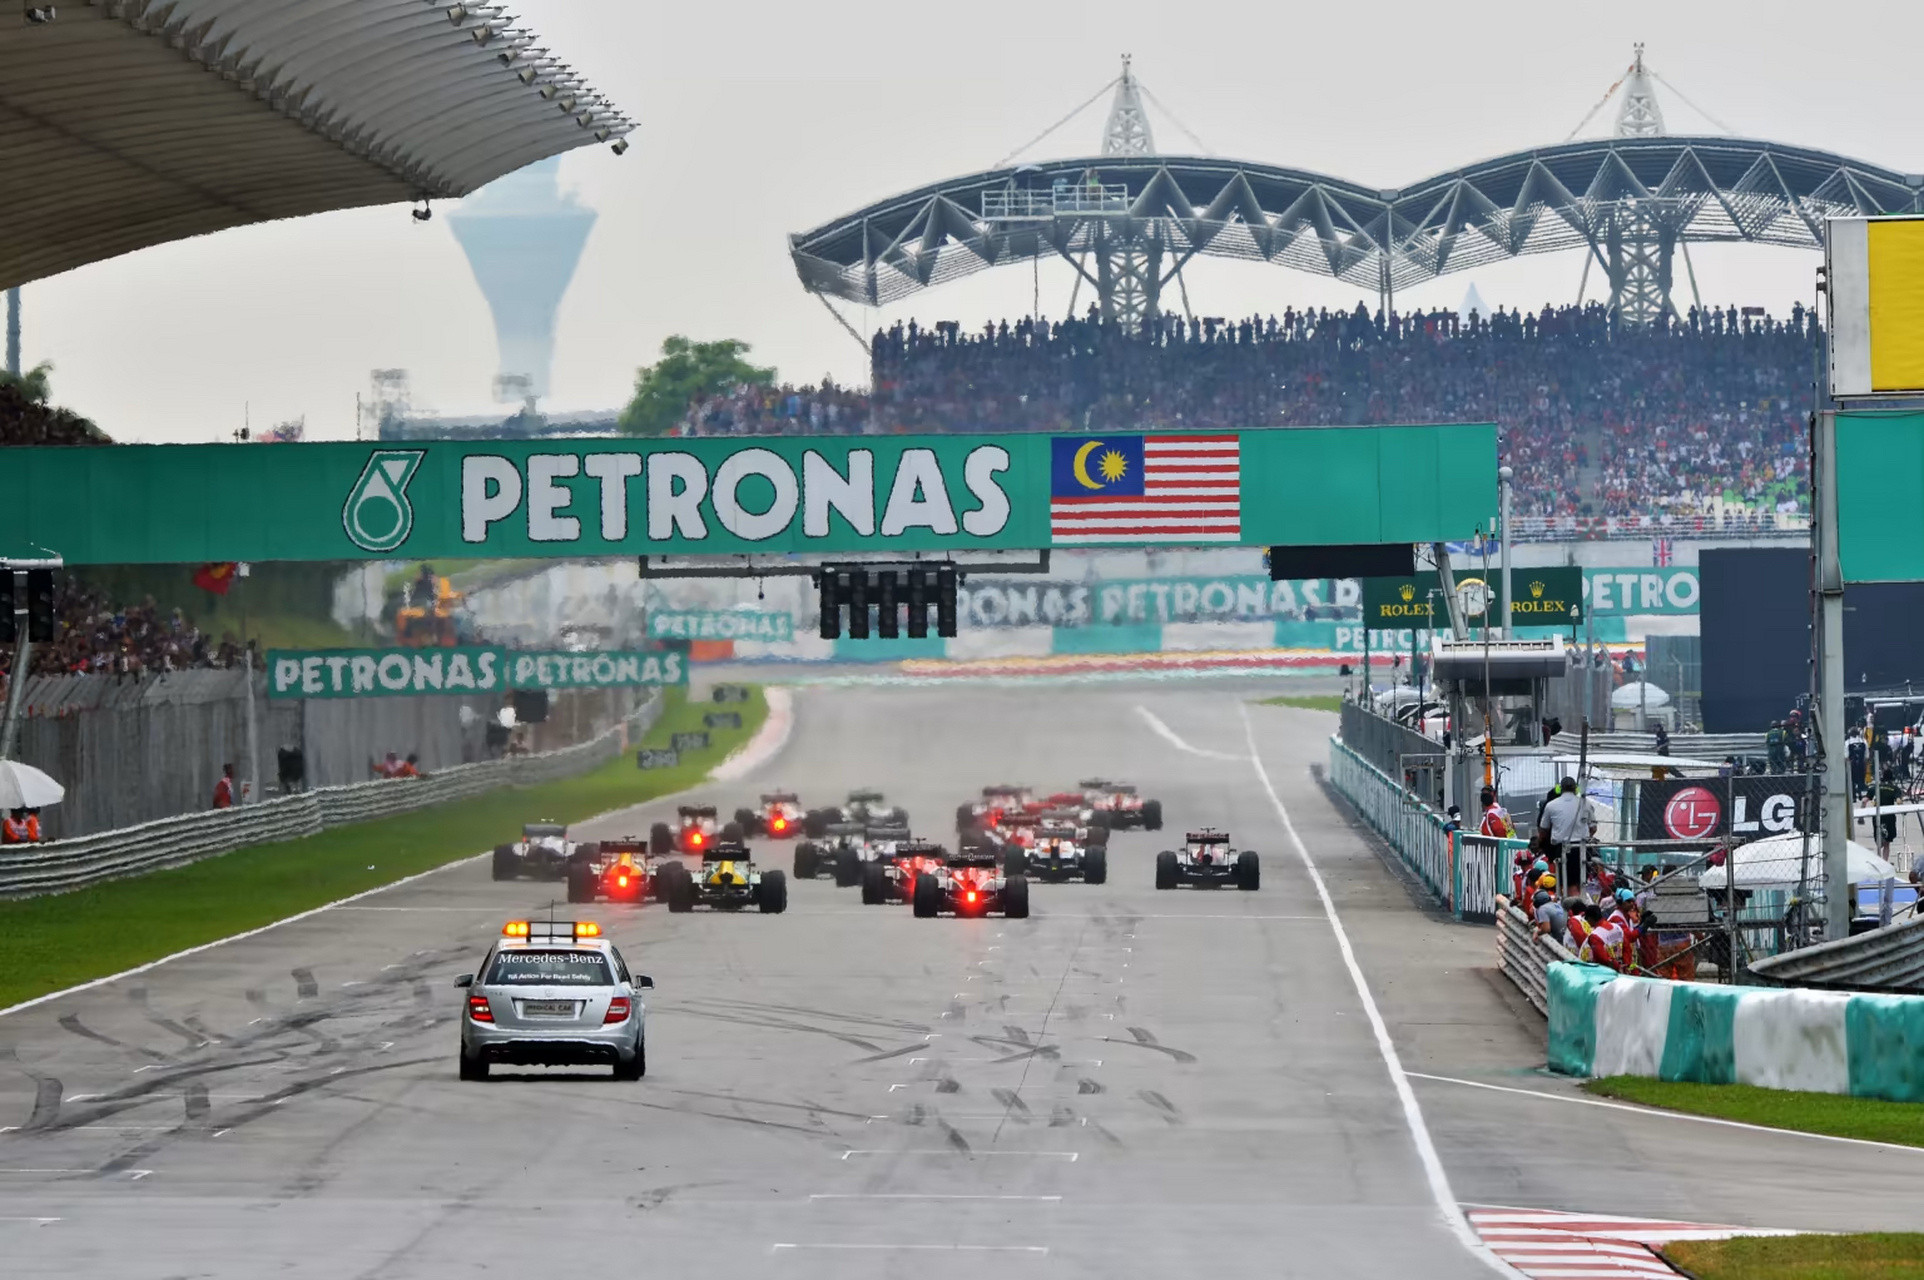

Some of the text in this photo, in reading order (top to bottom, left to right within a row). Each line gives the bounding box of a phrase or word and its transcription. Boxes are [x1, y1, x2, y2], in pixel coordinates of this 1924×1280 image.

[461, 445, 1011, 543] PETRONAS
[1102, 578, 1320, 621] PETRONAS
[1380, 603, 1435, 617] ROLEX
[1511, 600, 1565, 613] ROLEX
[654, 614, 788, 636] PETRONAS
[275, 652, 497, 693] PETRONAS
[515, 653, 682, 684] PETRONAS
[1733, 794, 1795, 832] LG
[498, 953, 603, 964] Mercedes-Benz
